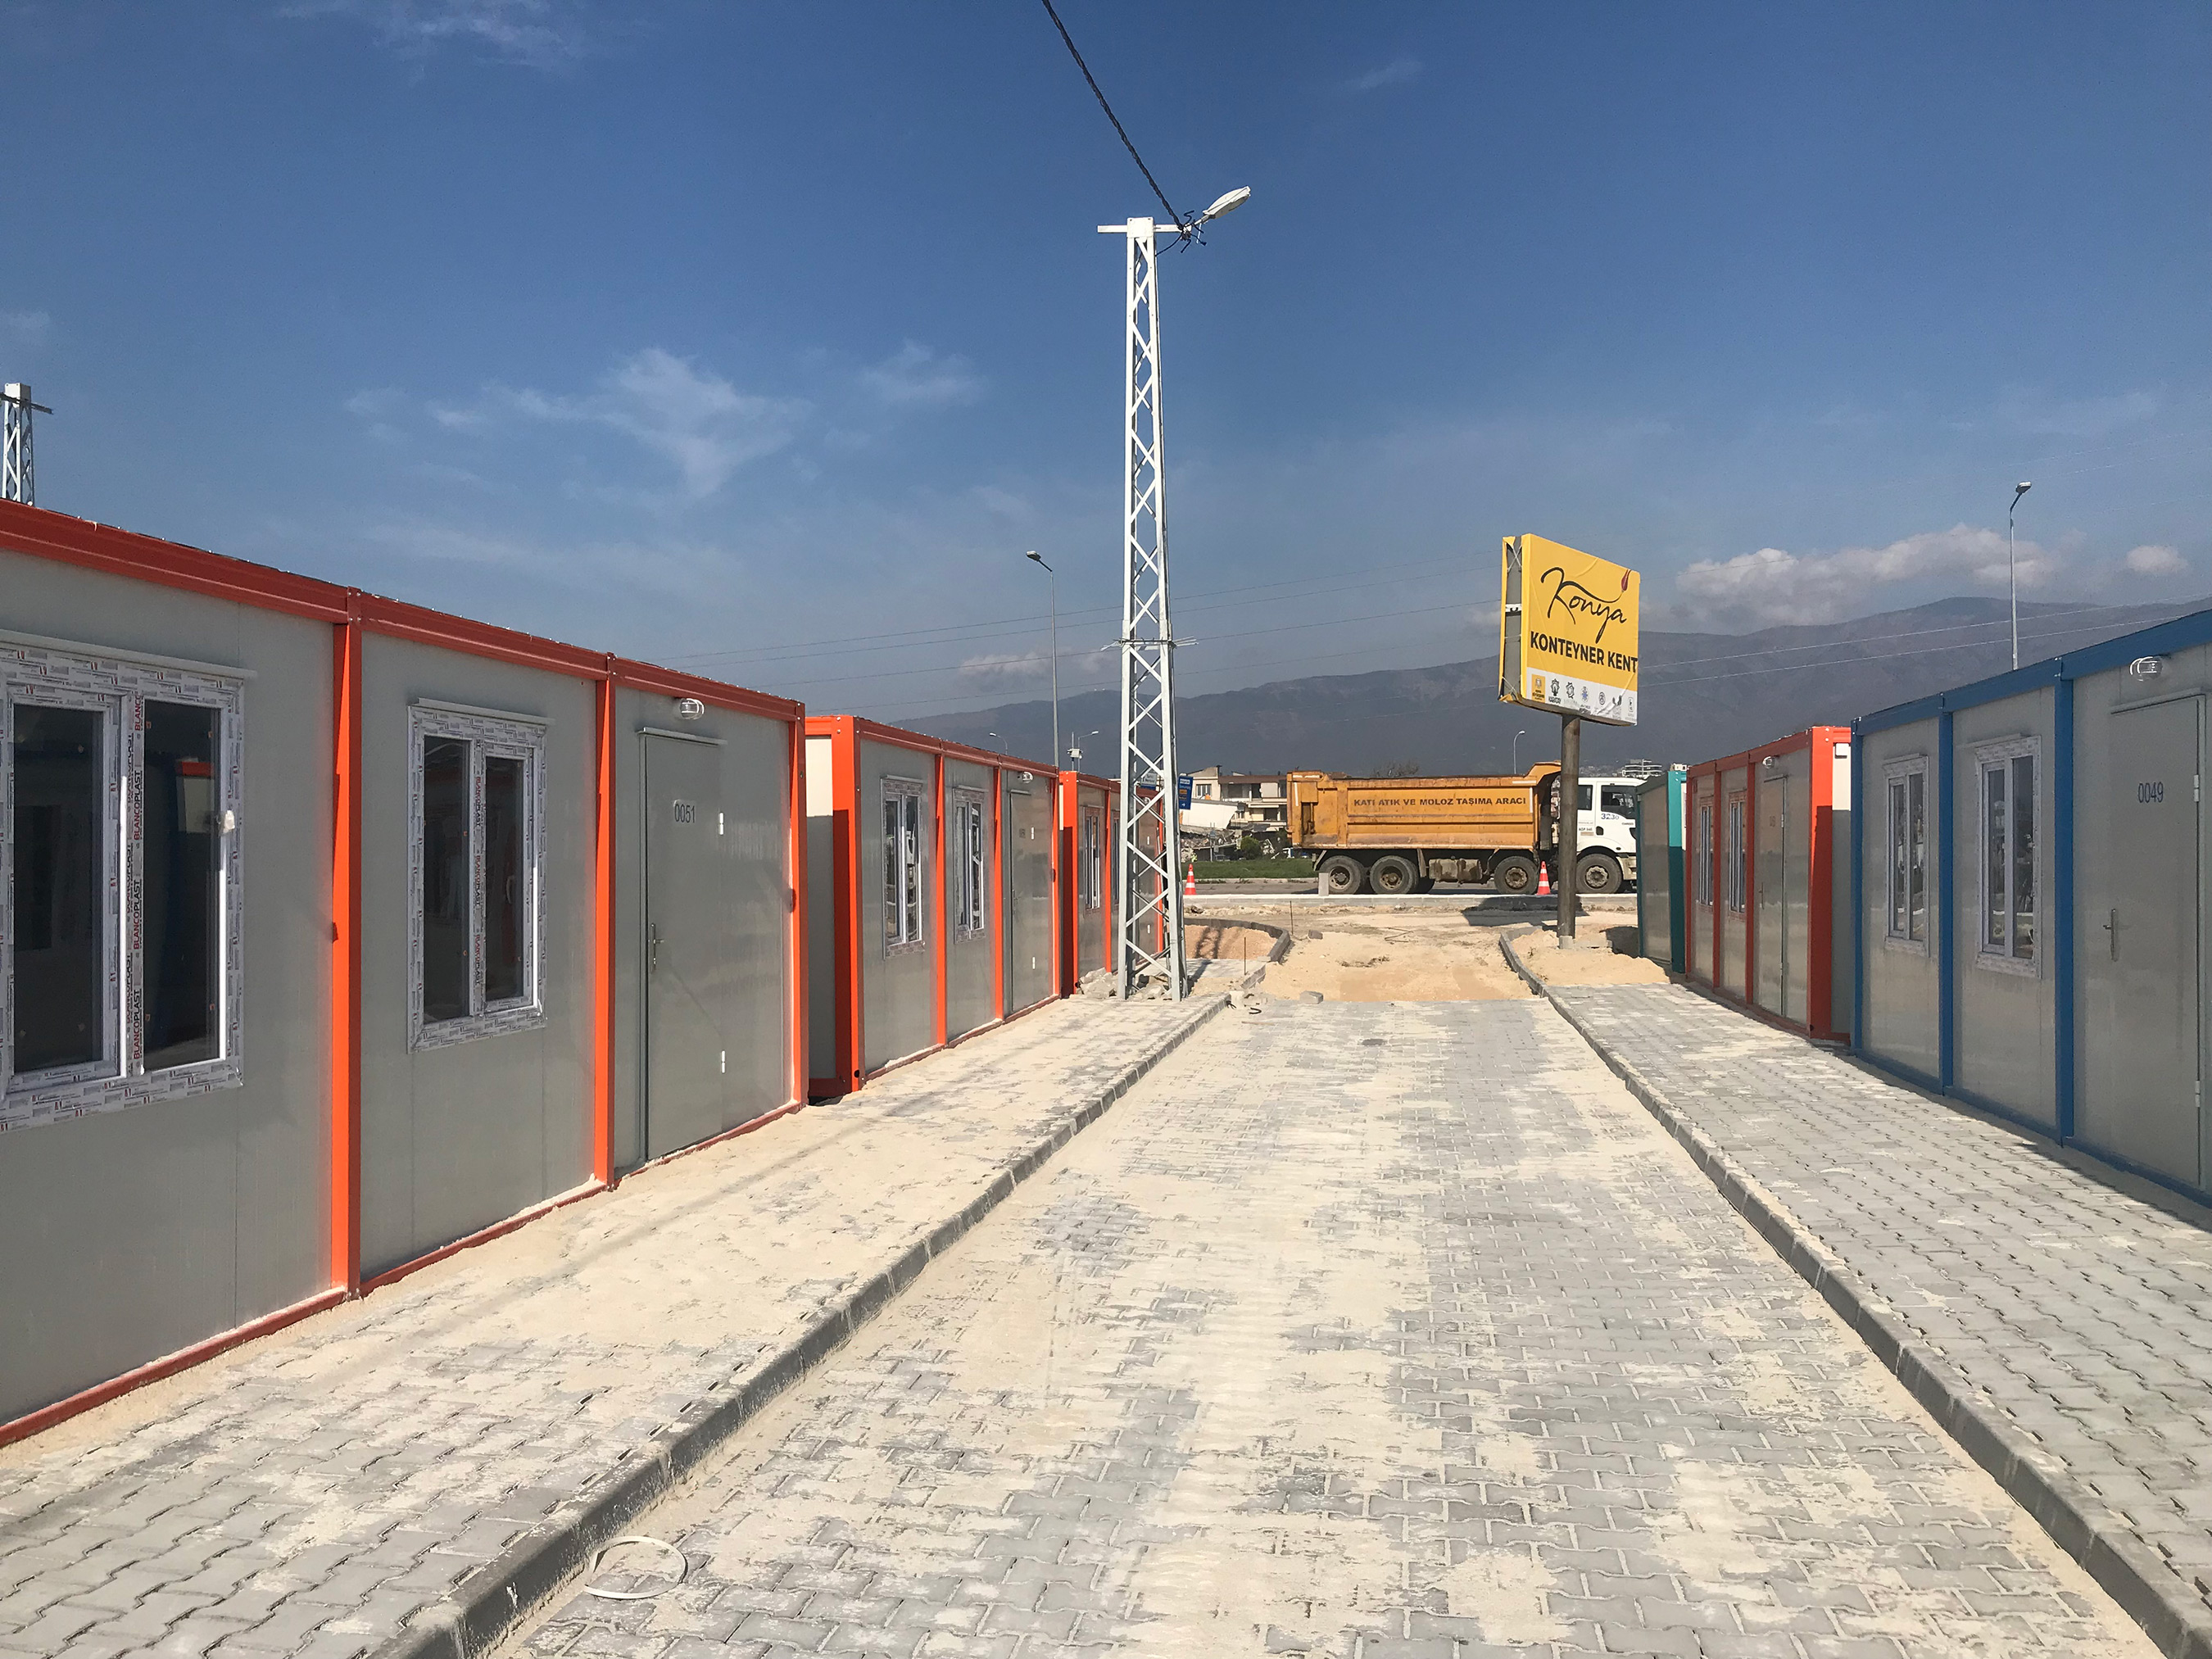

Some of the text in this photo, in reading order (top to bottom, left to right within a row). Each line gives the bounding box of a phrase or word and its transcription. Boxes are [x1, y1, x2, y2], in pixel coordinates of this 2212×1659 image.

[1540, 567, 1627, 644] Konya
[1530, 631, 1638, 673] KONTEYNER KENT
[2138, 782, 2164, 803] 0049
[674, 804, 696, 823] 0051
